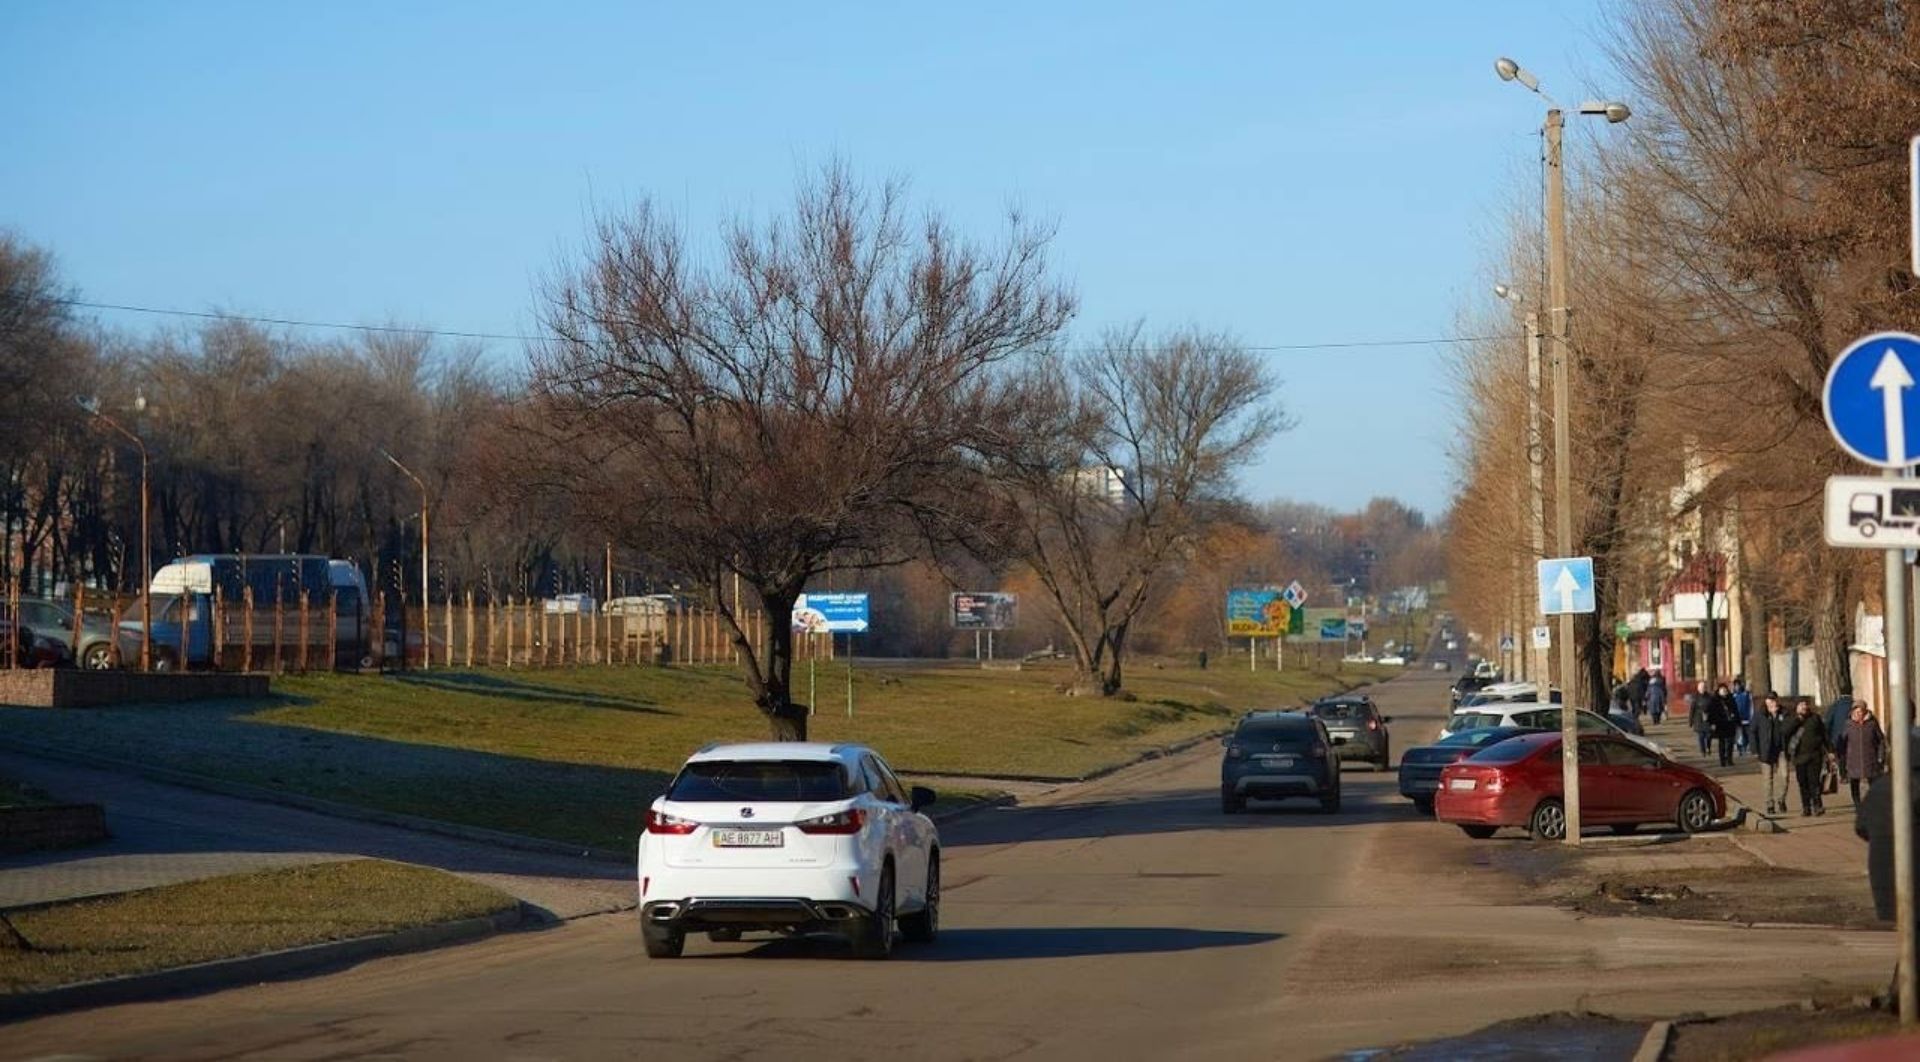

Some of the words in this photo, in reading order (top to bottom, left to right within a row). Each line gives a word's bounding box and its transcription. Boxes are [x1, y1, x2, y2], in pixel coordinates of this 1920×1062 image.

[721, 832, 736, 844] AE
[738, 832, 761, 844] 8877
[764, 832, 779, 844] AH
